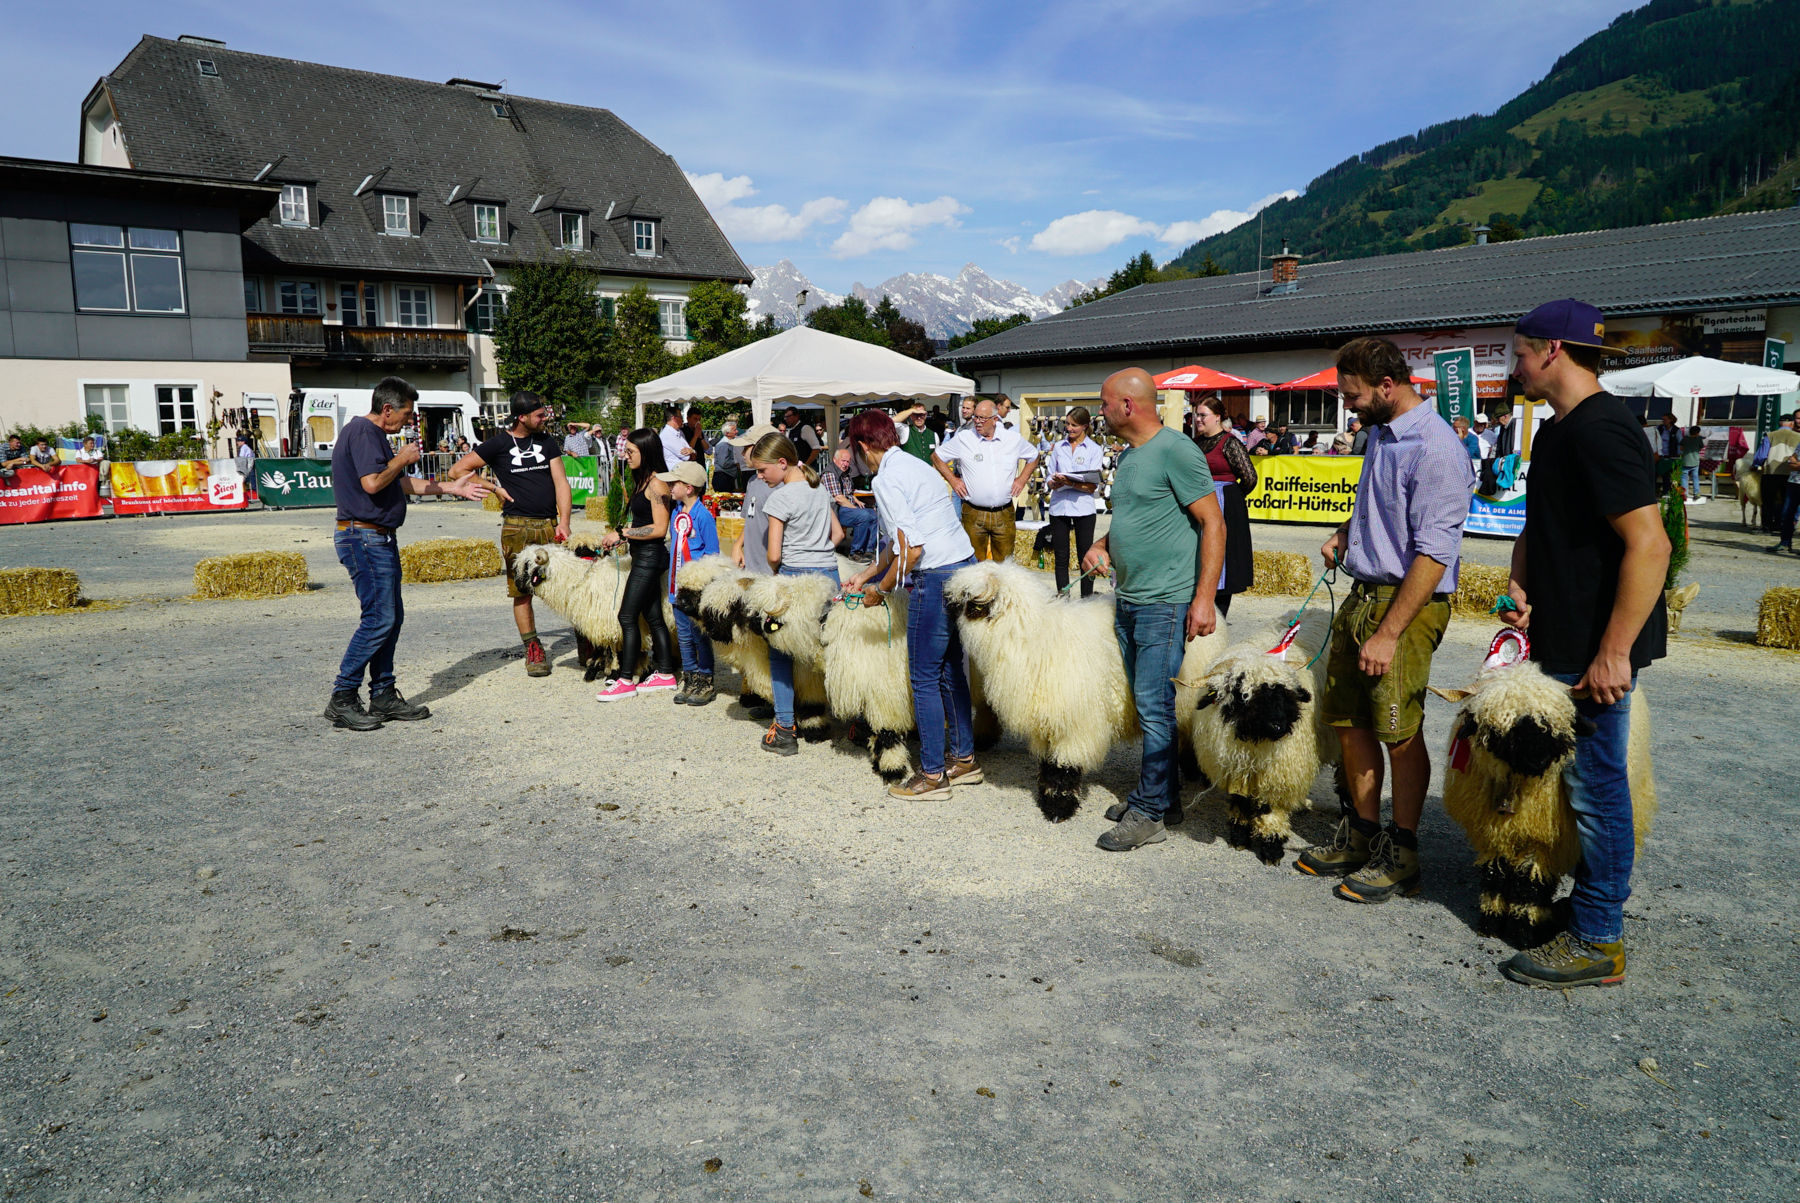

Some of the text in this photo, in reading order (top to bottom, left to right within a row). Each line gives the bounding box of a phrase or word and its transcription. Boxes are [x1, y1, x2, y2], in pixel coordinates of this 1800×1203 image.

[310, 399, 335, 408] Eder
[293, 471, 332, 488] Tau
[213, 483, 237, 496] Stiegl
[19, 498, 40, 507] jeder
